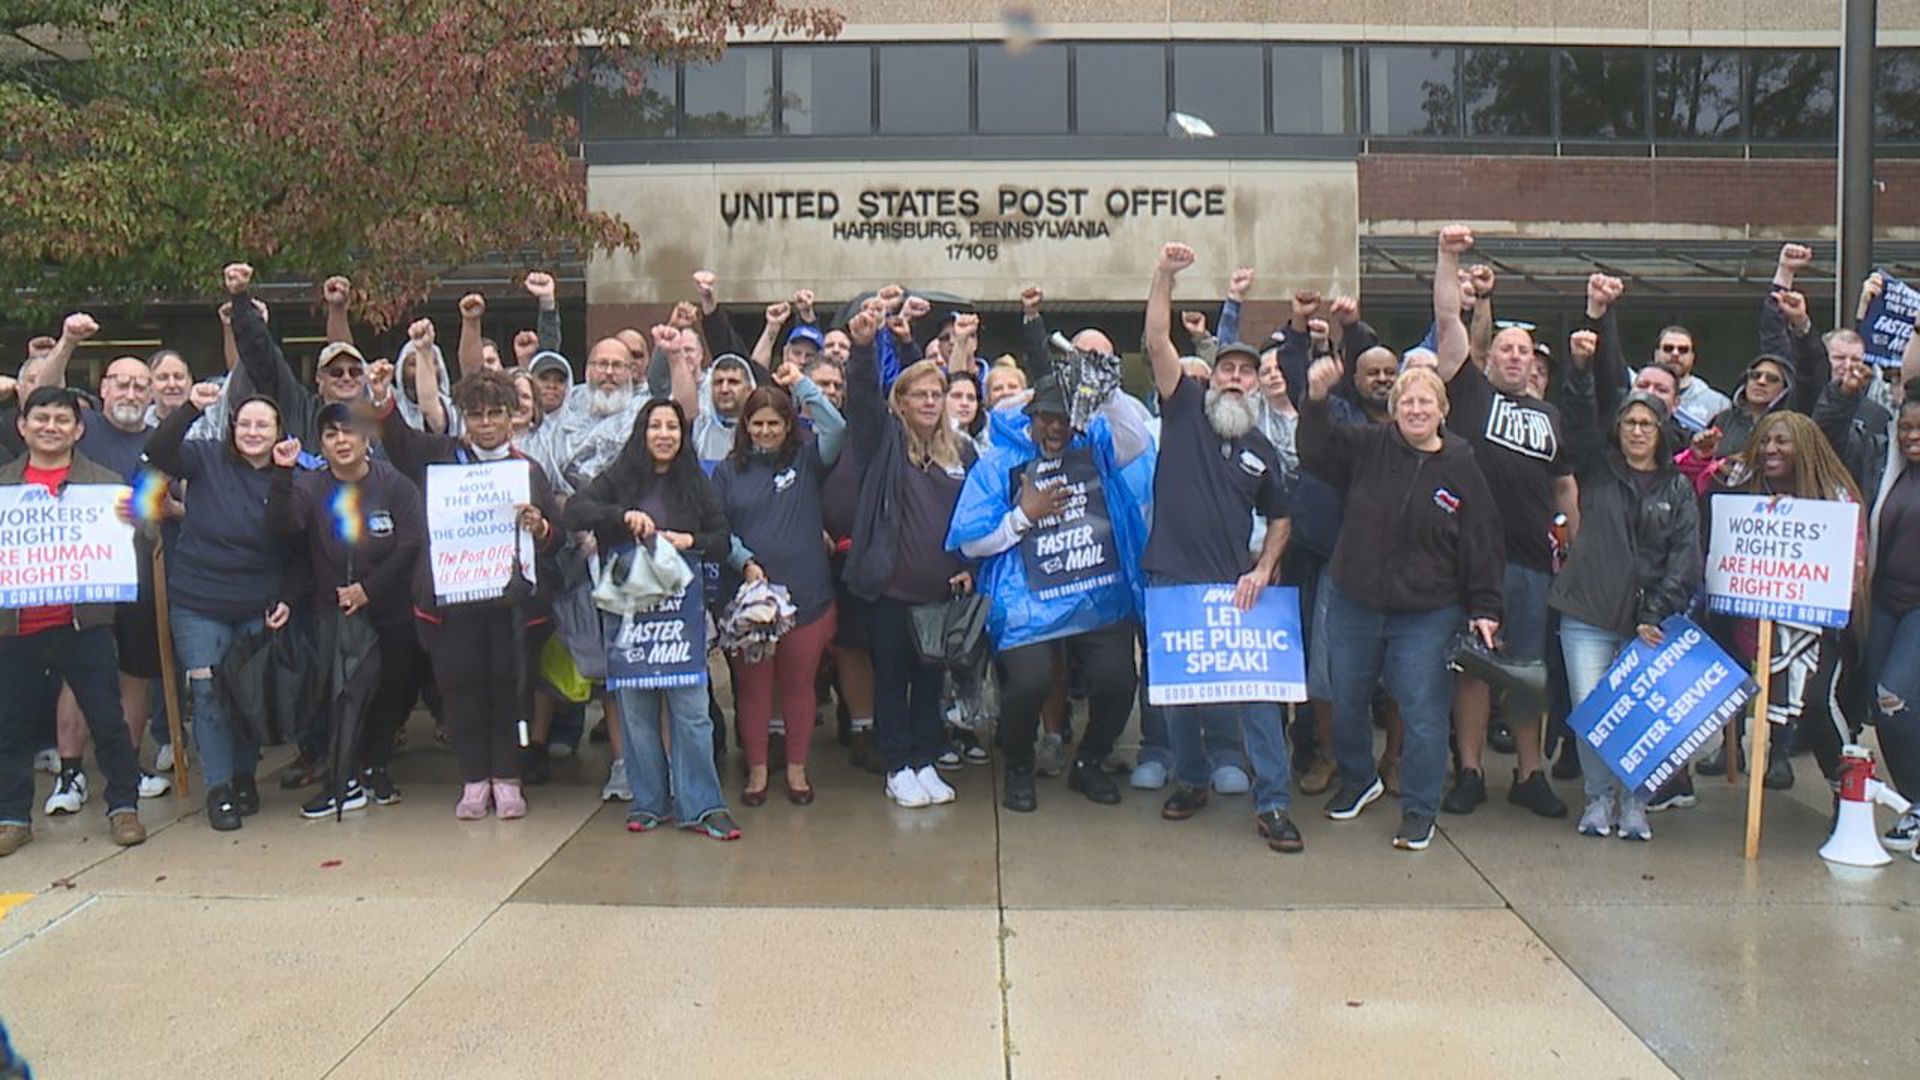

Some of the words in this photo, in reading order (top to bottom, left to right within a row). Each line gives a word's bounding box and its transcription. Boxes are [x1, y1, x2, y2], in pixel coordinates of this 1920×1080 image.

[720, 190, 839, 219] UNITED
[857, 189, 979, 218] STATES
[998, 189, 1088, 217] POST
[1104, 189, 1225, 217] OFFICE
[833, 221, 961, 240] HARRISBURG,
[969, 221, 1110, 239] PENNSYLVANIA
[945, 243, 998, 261] 17106
[1873, 315, 1914, 338] FASTE
[459, 481, 496, 493] MOVE
[444, 495, 472, 507] THE
[476, 491, 514, 504] MAIL
[463, 509, 496, 524] NOT
[1, 526, 82, 547] RIGHTS
[432, 528, 454, 541] THE
[1729, 517, 1827, 540] WORKERS'
[1036, 525, 1094, 557] FASTER
[1735, 537, 1803, 559] RIGHTS
[27, 545, 112, 565] HUMAN
[460, 549, 485, 565] Post
[1065, 544, 1104, 571] MAIL
[0, 563, 89, 586] RIGHTS!
[1718, 556, 1746, 574] ARE
[1750, 559, 1829, 582] HUMAN
[10, 586, 80, 604] CONTRACT
[85, 586, 120, 600] NOW!
[1729, 576, 1805, 601] RIGHTS!
[658, 600, 682, 613] SAY
[1206, 605, 1242, 627] LET
[1734, 598, 1793, 619] CONTRACT
[1798, 608, 1832, 623] NOW!
[622, 620, 684, 643] FASTER
[1161, 630, 1204, 653] THE
[1210, 628, 1288, 651] PUBLIC
[648, 641, 691, 664] MAIL
[1186, 651, 1268, 673] SPEAK!
[1165, 686, 1194, 699] GOOD
[1200, 684, 1259, 699] CONTRACT
[1264, 684, 1291, 697] NOW!
[1587, 693, 1637, 748] BETTER
[1630, 627, 1702, 699] STAFFING
[1645, 692, 1667, 714] IS
[1619, 718, 1673, 774] BETTER
[1666, 660, 1728, 725] SERVICE
[1670, 713, 1722, 766] CONTRACT
[1717, 687, 1748, 720] NOW!
